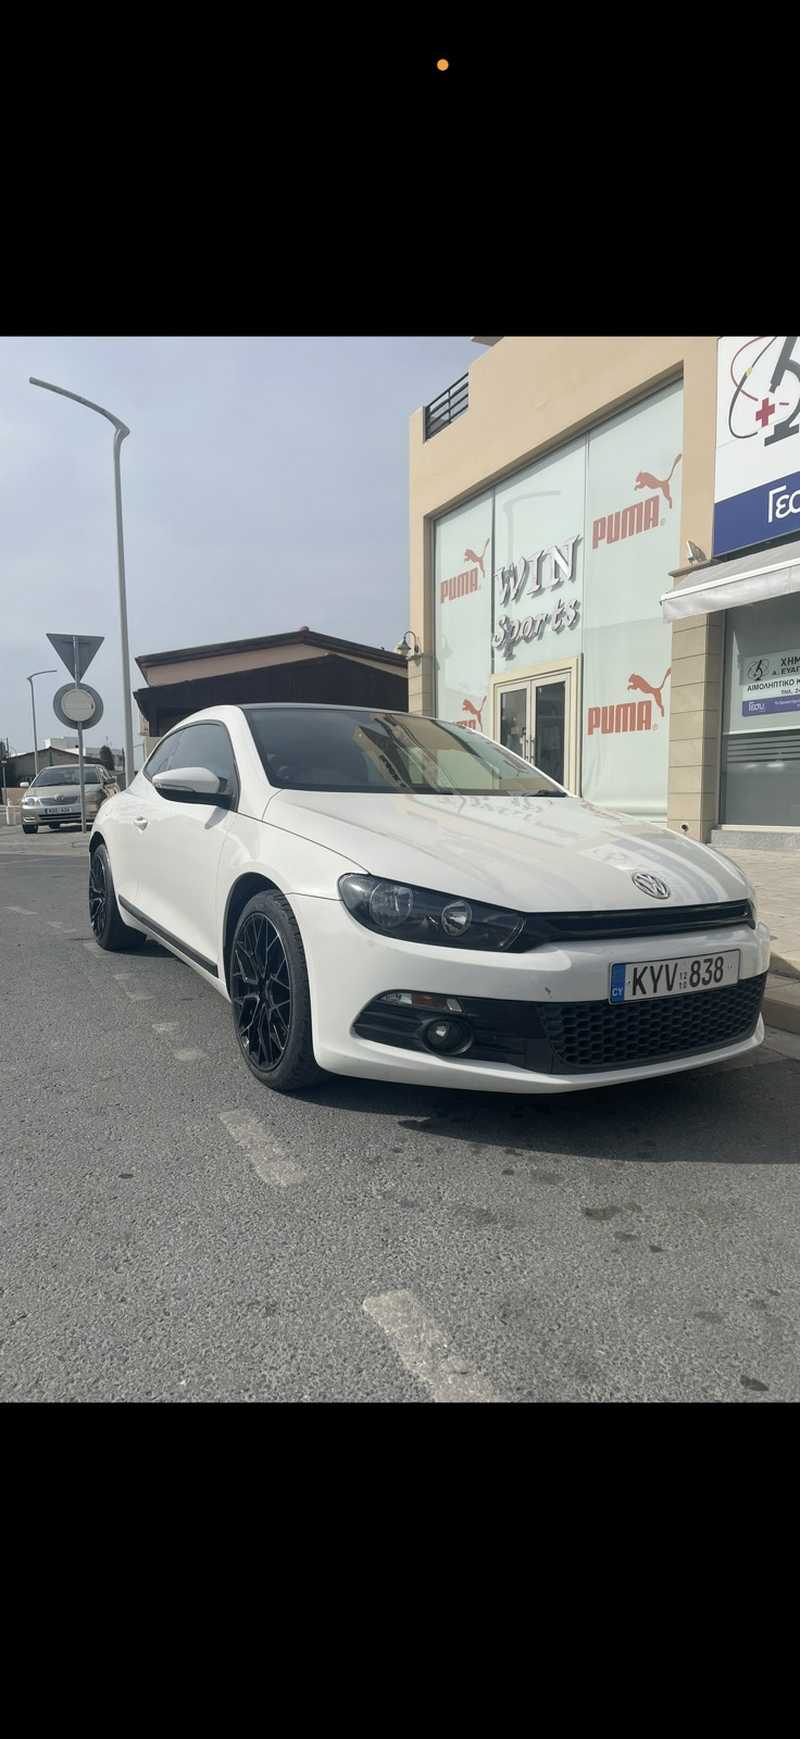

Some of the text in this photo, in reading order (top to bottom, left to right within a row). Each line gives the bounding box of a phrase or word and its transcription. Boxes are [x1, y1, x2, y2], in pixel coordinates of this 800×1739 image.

[592, 495, 660, 549] PUMA
[440, 567, 478, 603] PUMA
[496, 536, 580, 606] WIN
[491, 599, 580, 659] Sports
[588, 700, 652, 735] PUMA
[611, 986, 624, 997] CY
[632, 956, 724, 995] KYV 838
